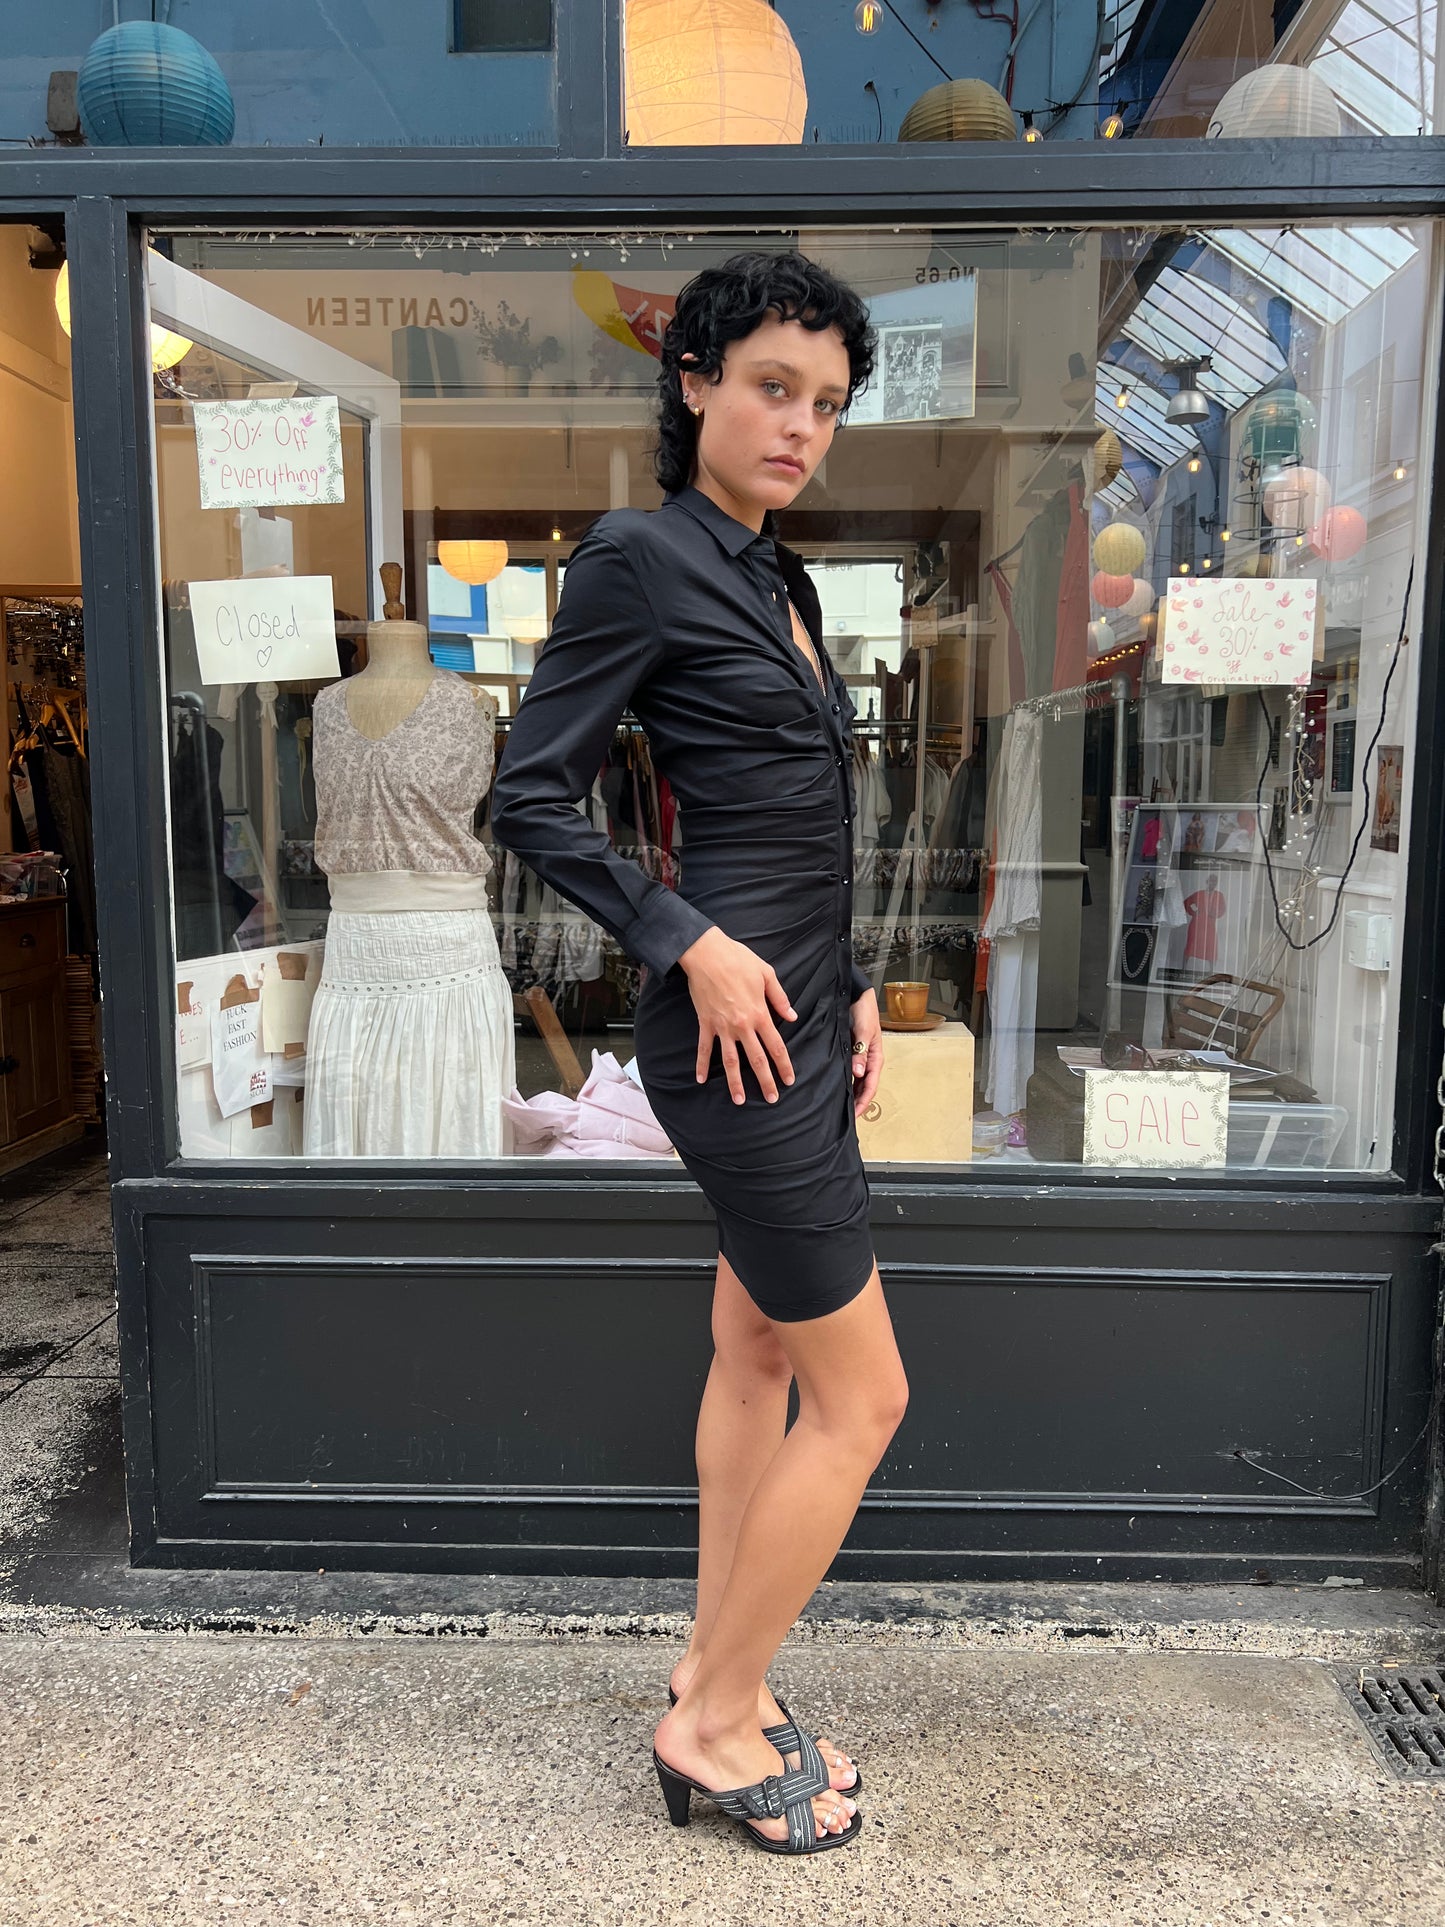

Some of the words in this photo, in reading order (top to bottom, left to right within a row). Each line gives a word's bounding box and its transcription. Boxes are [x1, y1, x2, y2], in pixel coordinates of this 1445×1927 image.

[211, 414, 262, 453] 30%
[275, 416, 309, 452] Off
[221, 463, 319, 497] everything
[1212, 589, 1272, 623] Sale
[215, 604, 301, 647] Closed
[1219, 626, 1258, 658] 30%
[1226, 659, 1242, 674] off
[222, 1030, 258, 1052] FASHION
[227, 1018, 247, 1035] FAST
